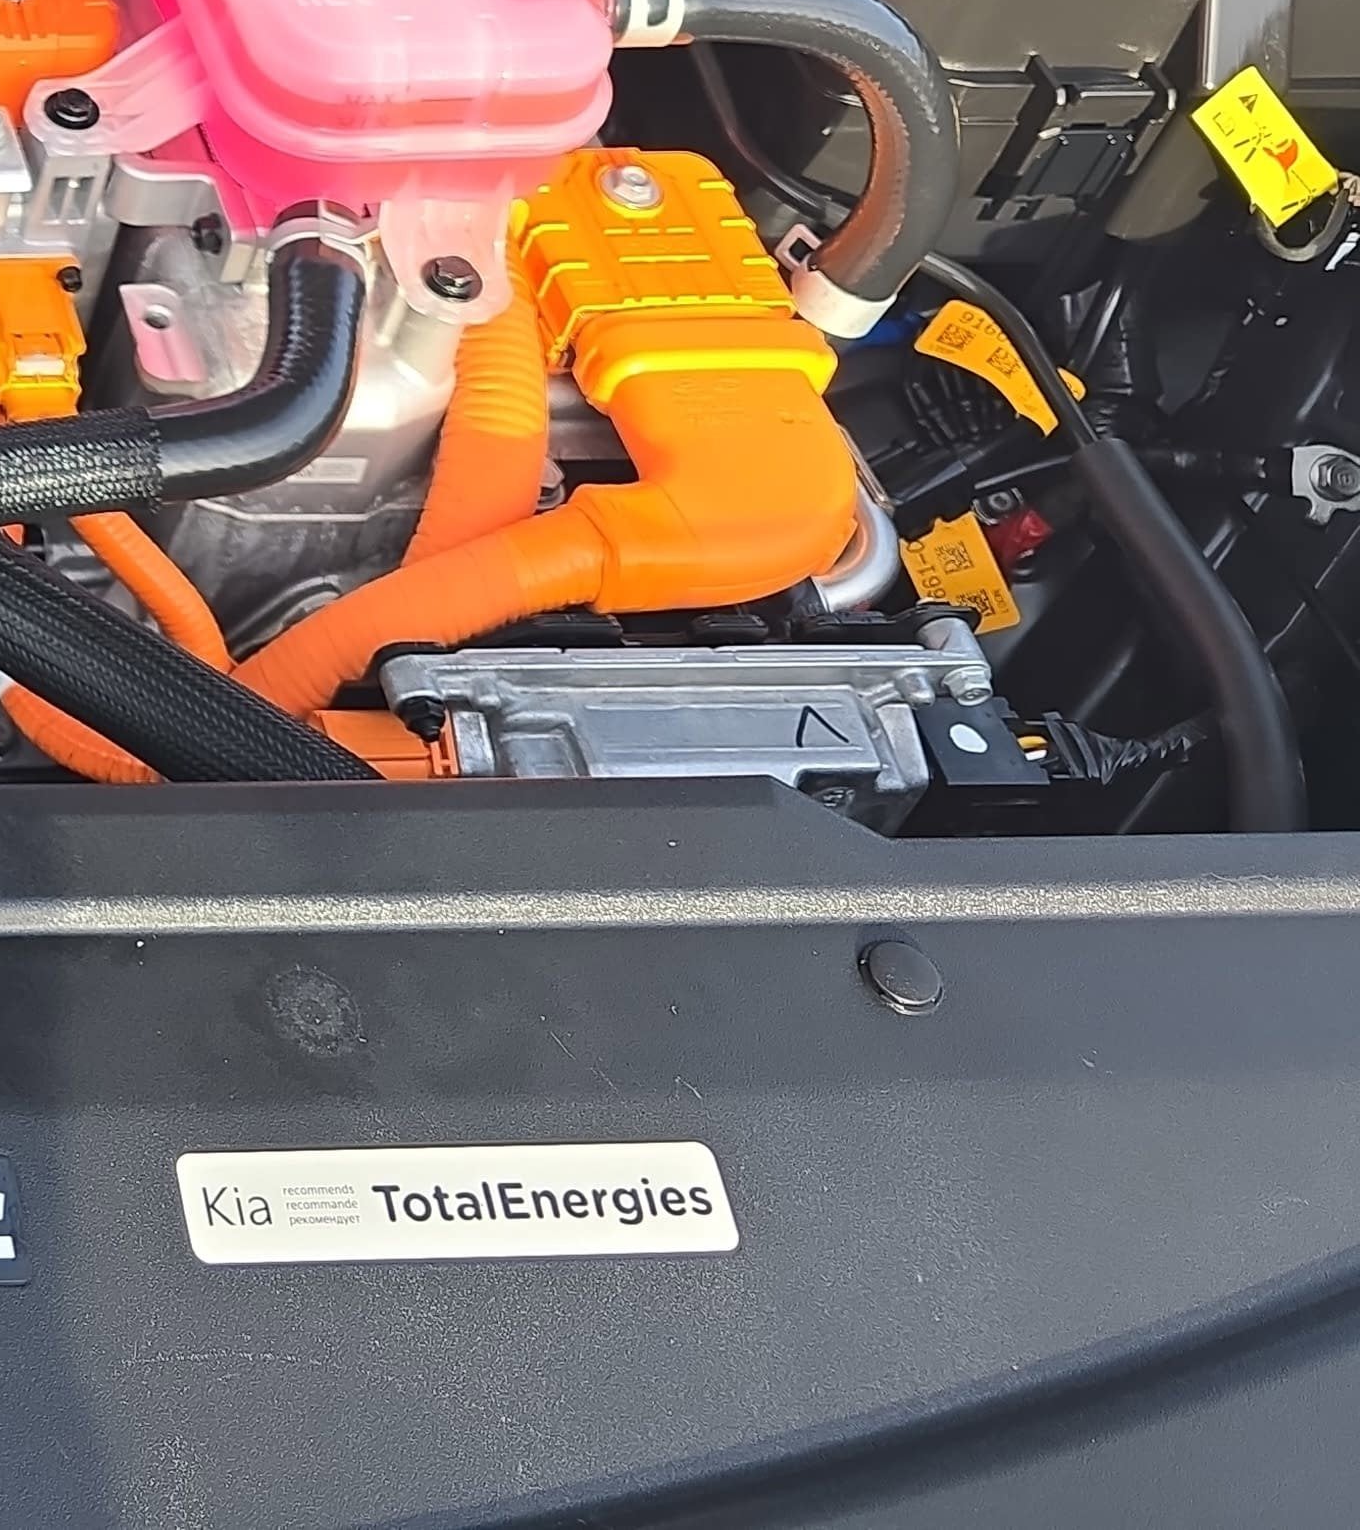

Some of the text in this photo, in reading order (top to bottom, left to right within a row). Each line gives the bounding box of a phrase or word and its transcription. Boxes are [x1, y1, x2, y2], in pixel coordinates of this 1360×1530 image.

[282, 1183, 355, 1197] recommends
[201, 1176, 714, 1228] Kia TotalEnergies
[285, 1197, 359, 1212] recommande
[288, 1212, 362, 1228] рекомендует
